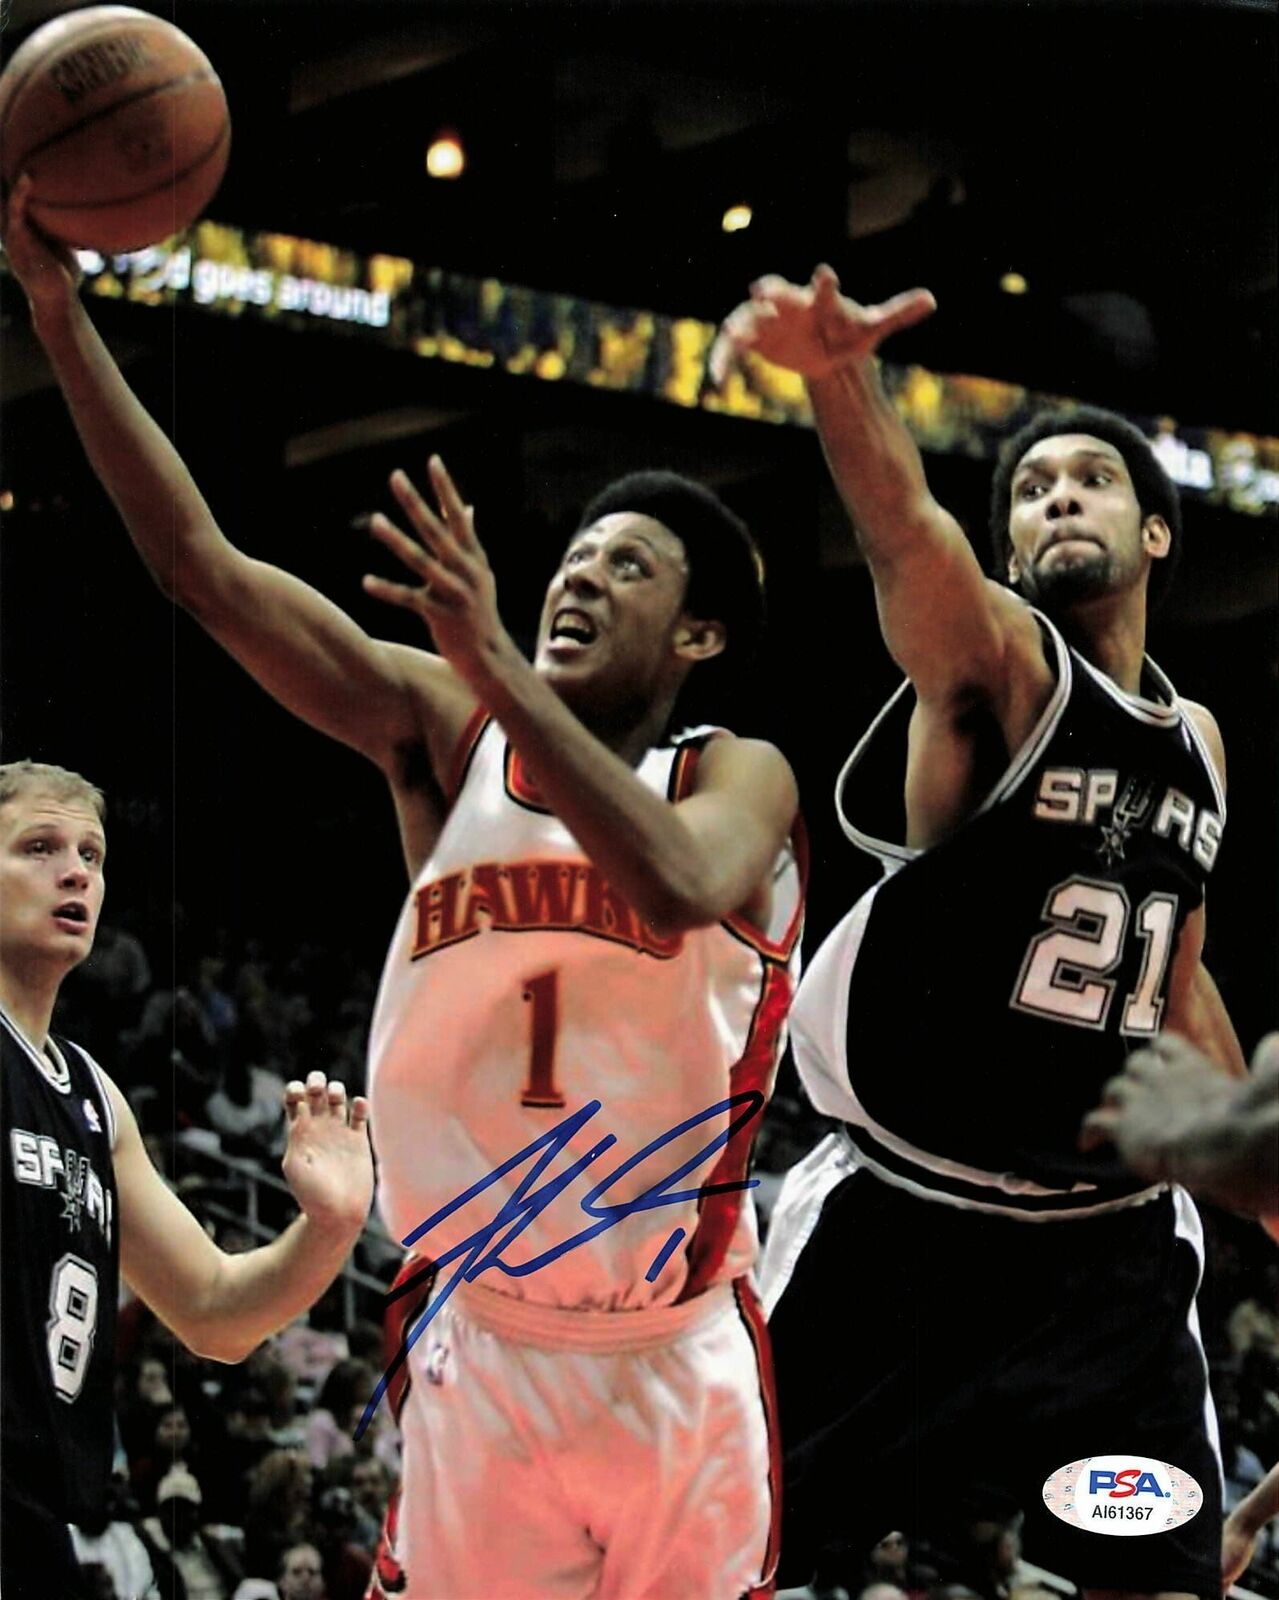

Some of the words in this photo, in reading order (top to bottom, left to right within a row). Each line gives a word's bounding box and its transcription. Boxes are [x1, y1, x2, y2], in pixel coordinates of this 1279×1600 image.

[279, 274, 390, 327] around
[1009, 873, 1179, 1037] 21
[521, 968, 566, 1108] 1
[47, 1252, 98, 1405] 8
